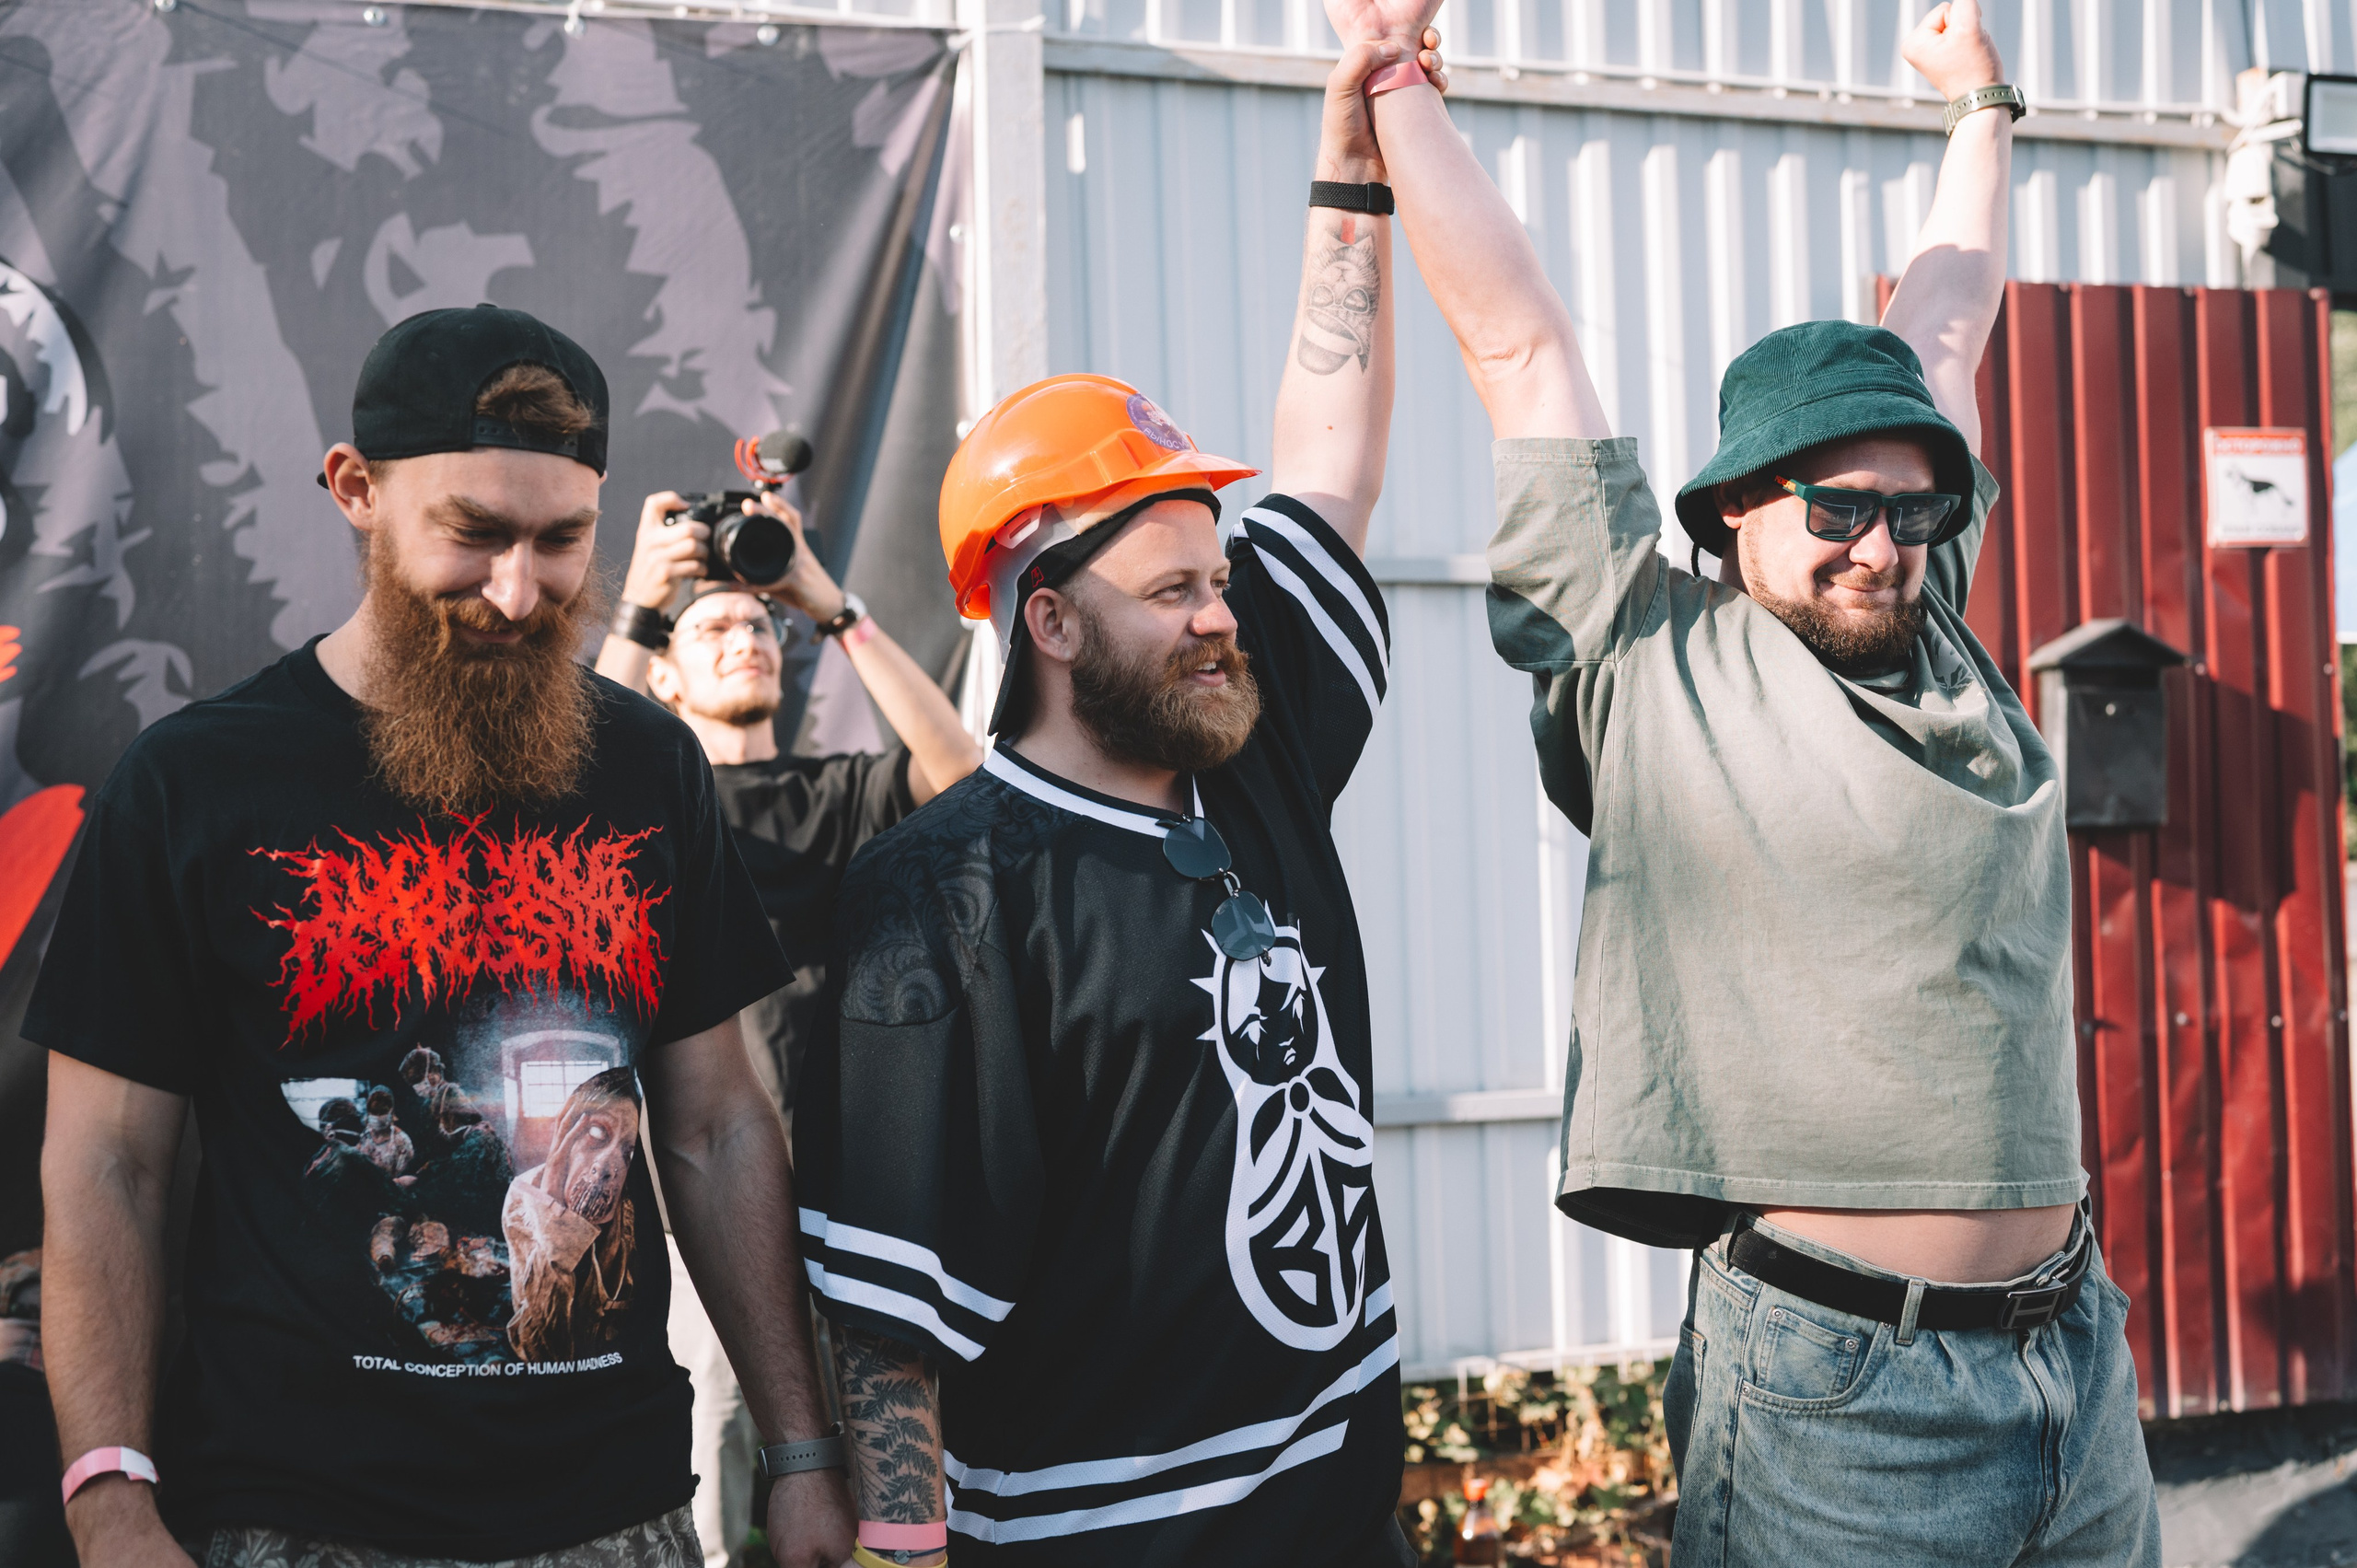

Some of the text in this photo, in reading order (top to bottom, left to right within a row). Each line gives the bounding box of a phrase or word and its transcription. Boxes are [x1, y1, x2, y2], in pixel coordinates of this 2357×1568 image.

[353, 1352, 623, 1377] TOTAL CONCEPTION OF HUMAN MADNESS
